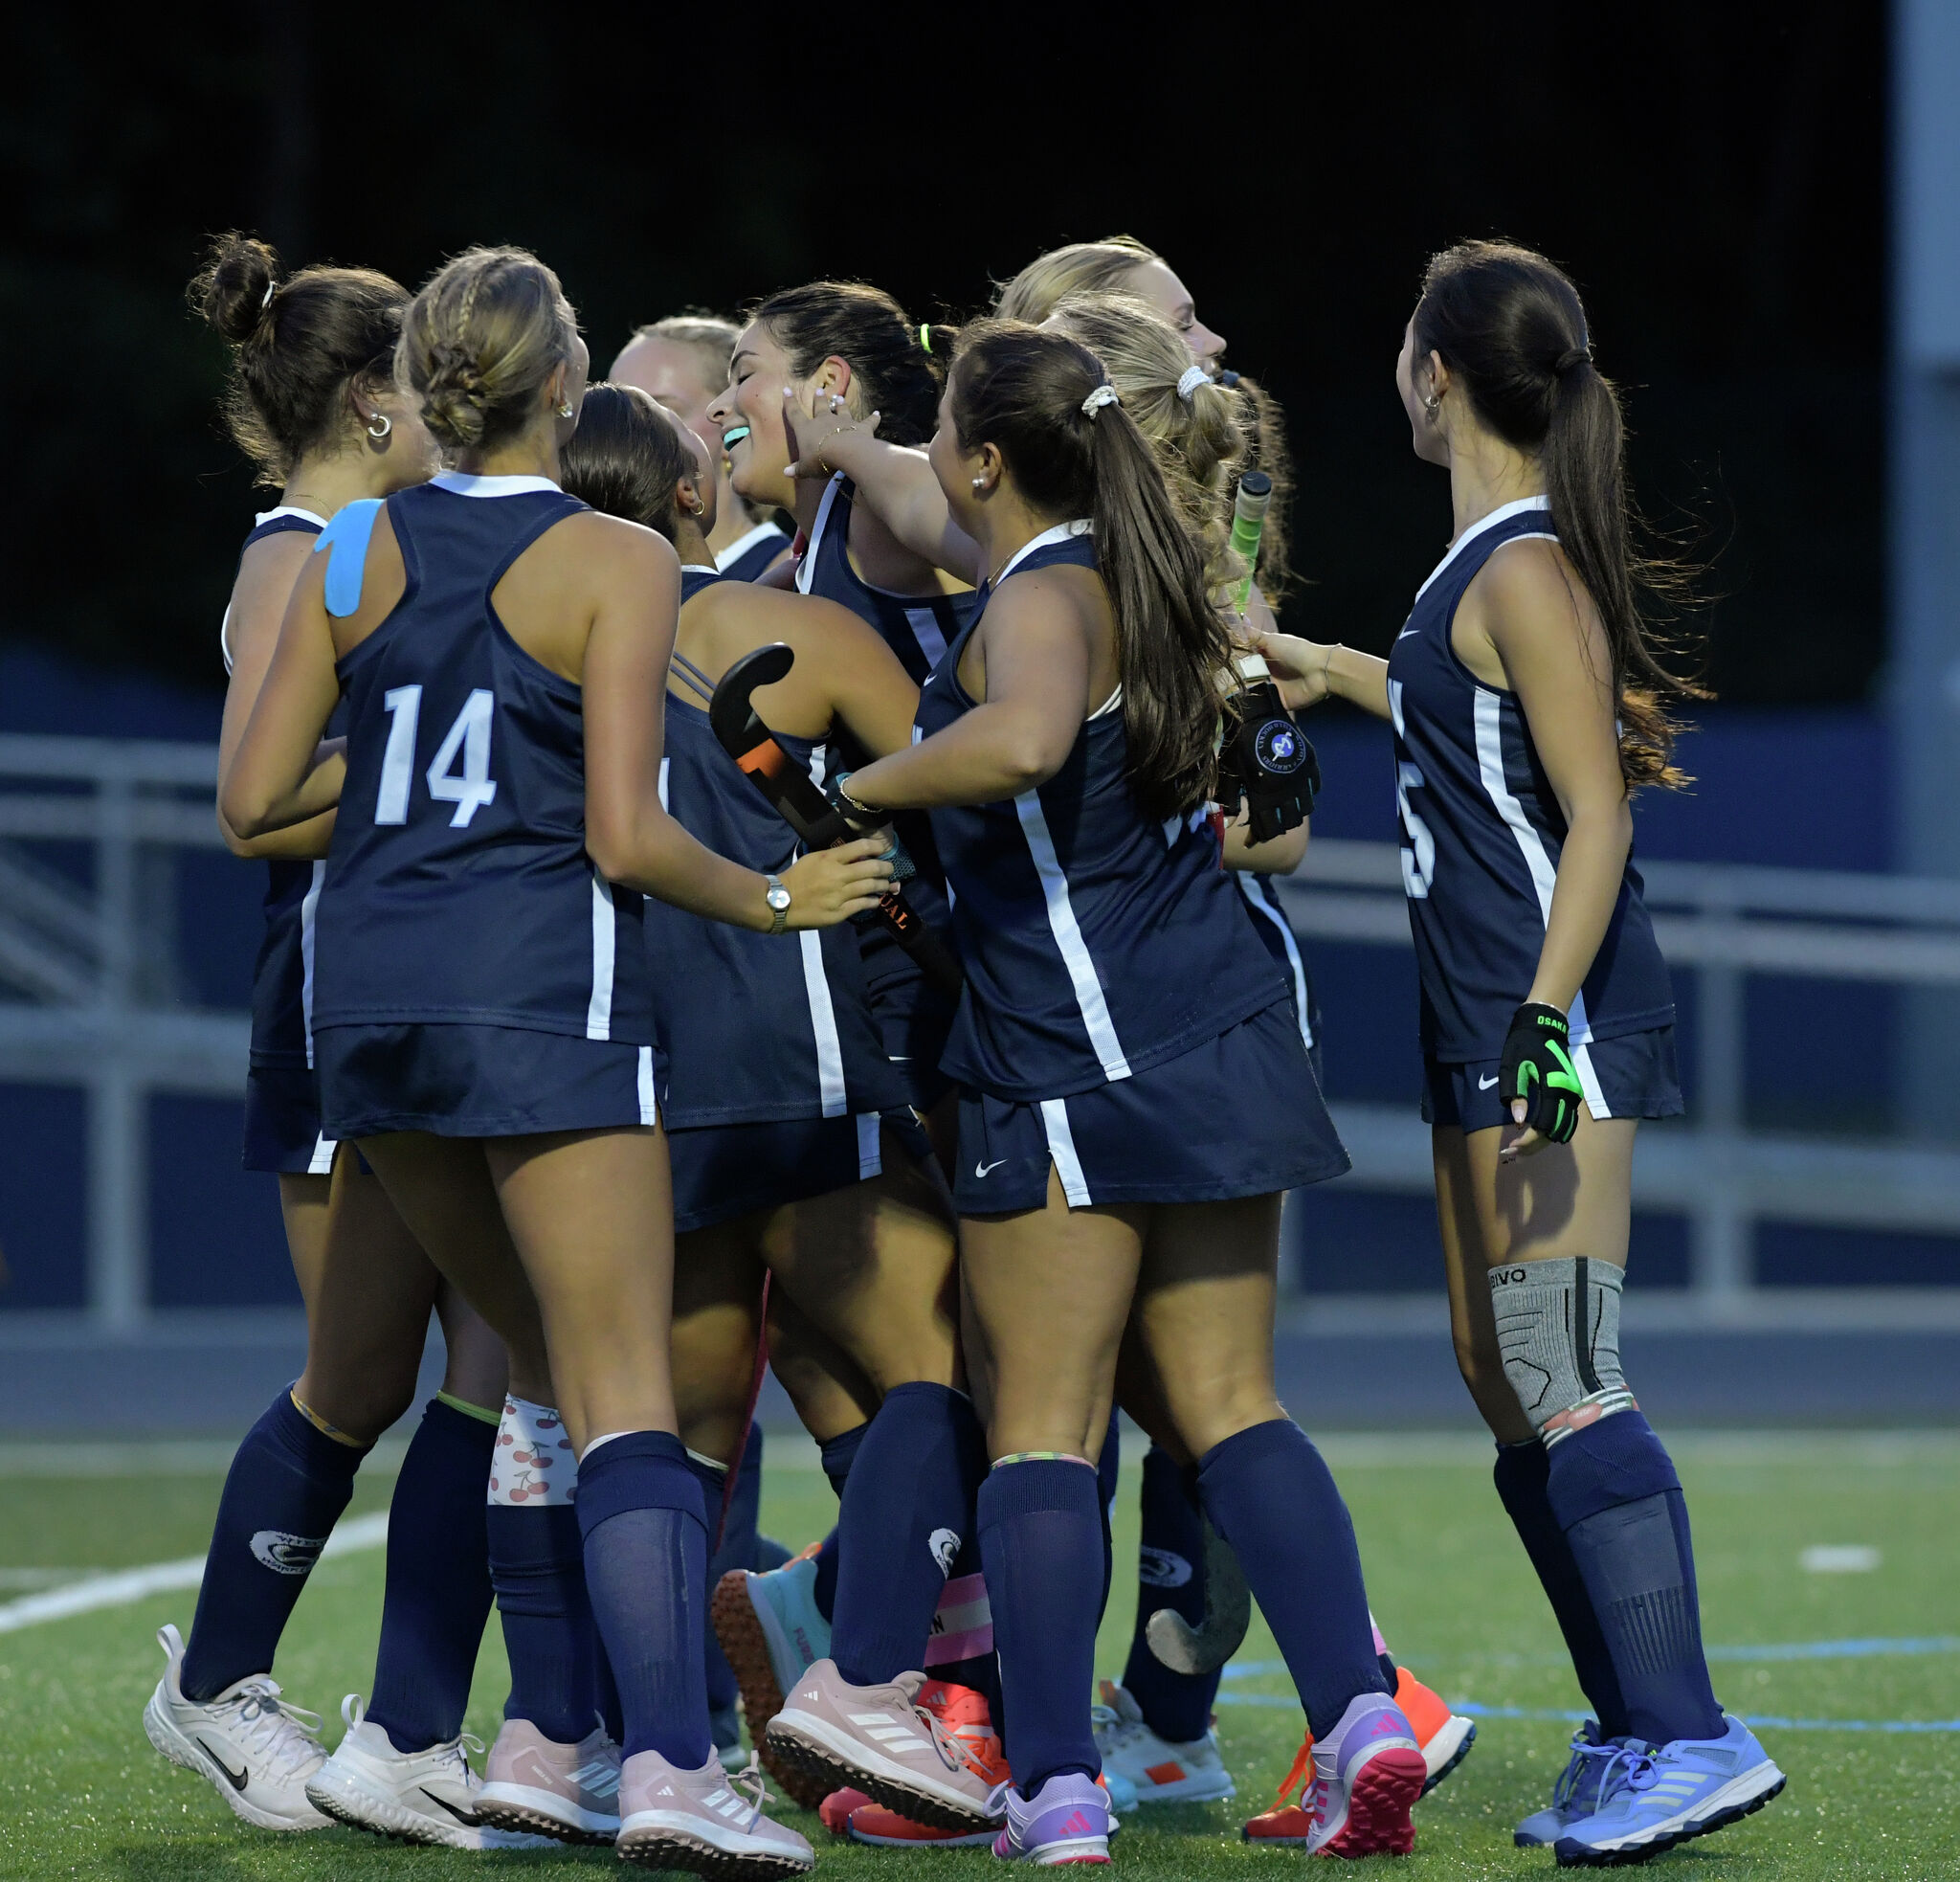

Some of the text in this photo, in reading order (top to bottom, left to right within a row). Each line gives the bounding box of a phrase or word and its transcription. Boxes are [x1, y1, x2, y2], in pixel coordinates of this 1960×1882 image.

[374, 683, 498, 828] 14
[1395, 760, 1436, 899] 5
[879, 892, 908, 930] UAL
[1537, 1016, 1567, 1034] OSAKA
